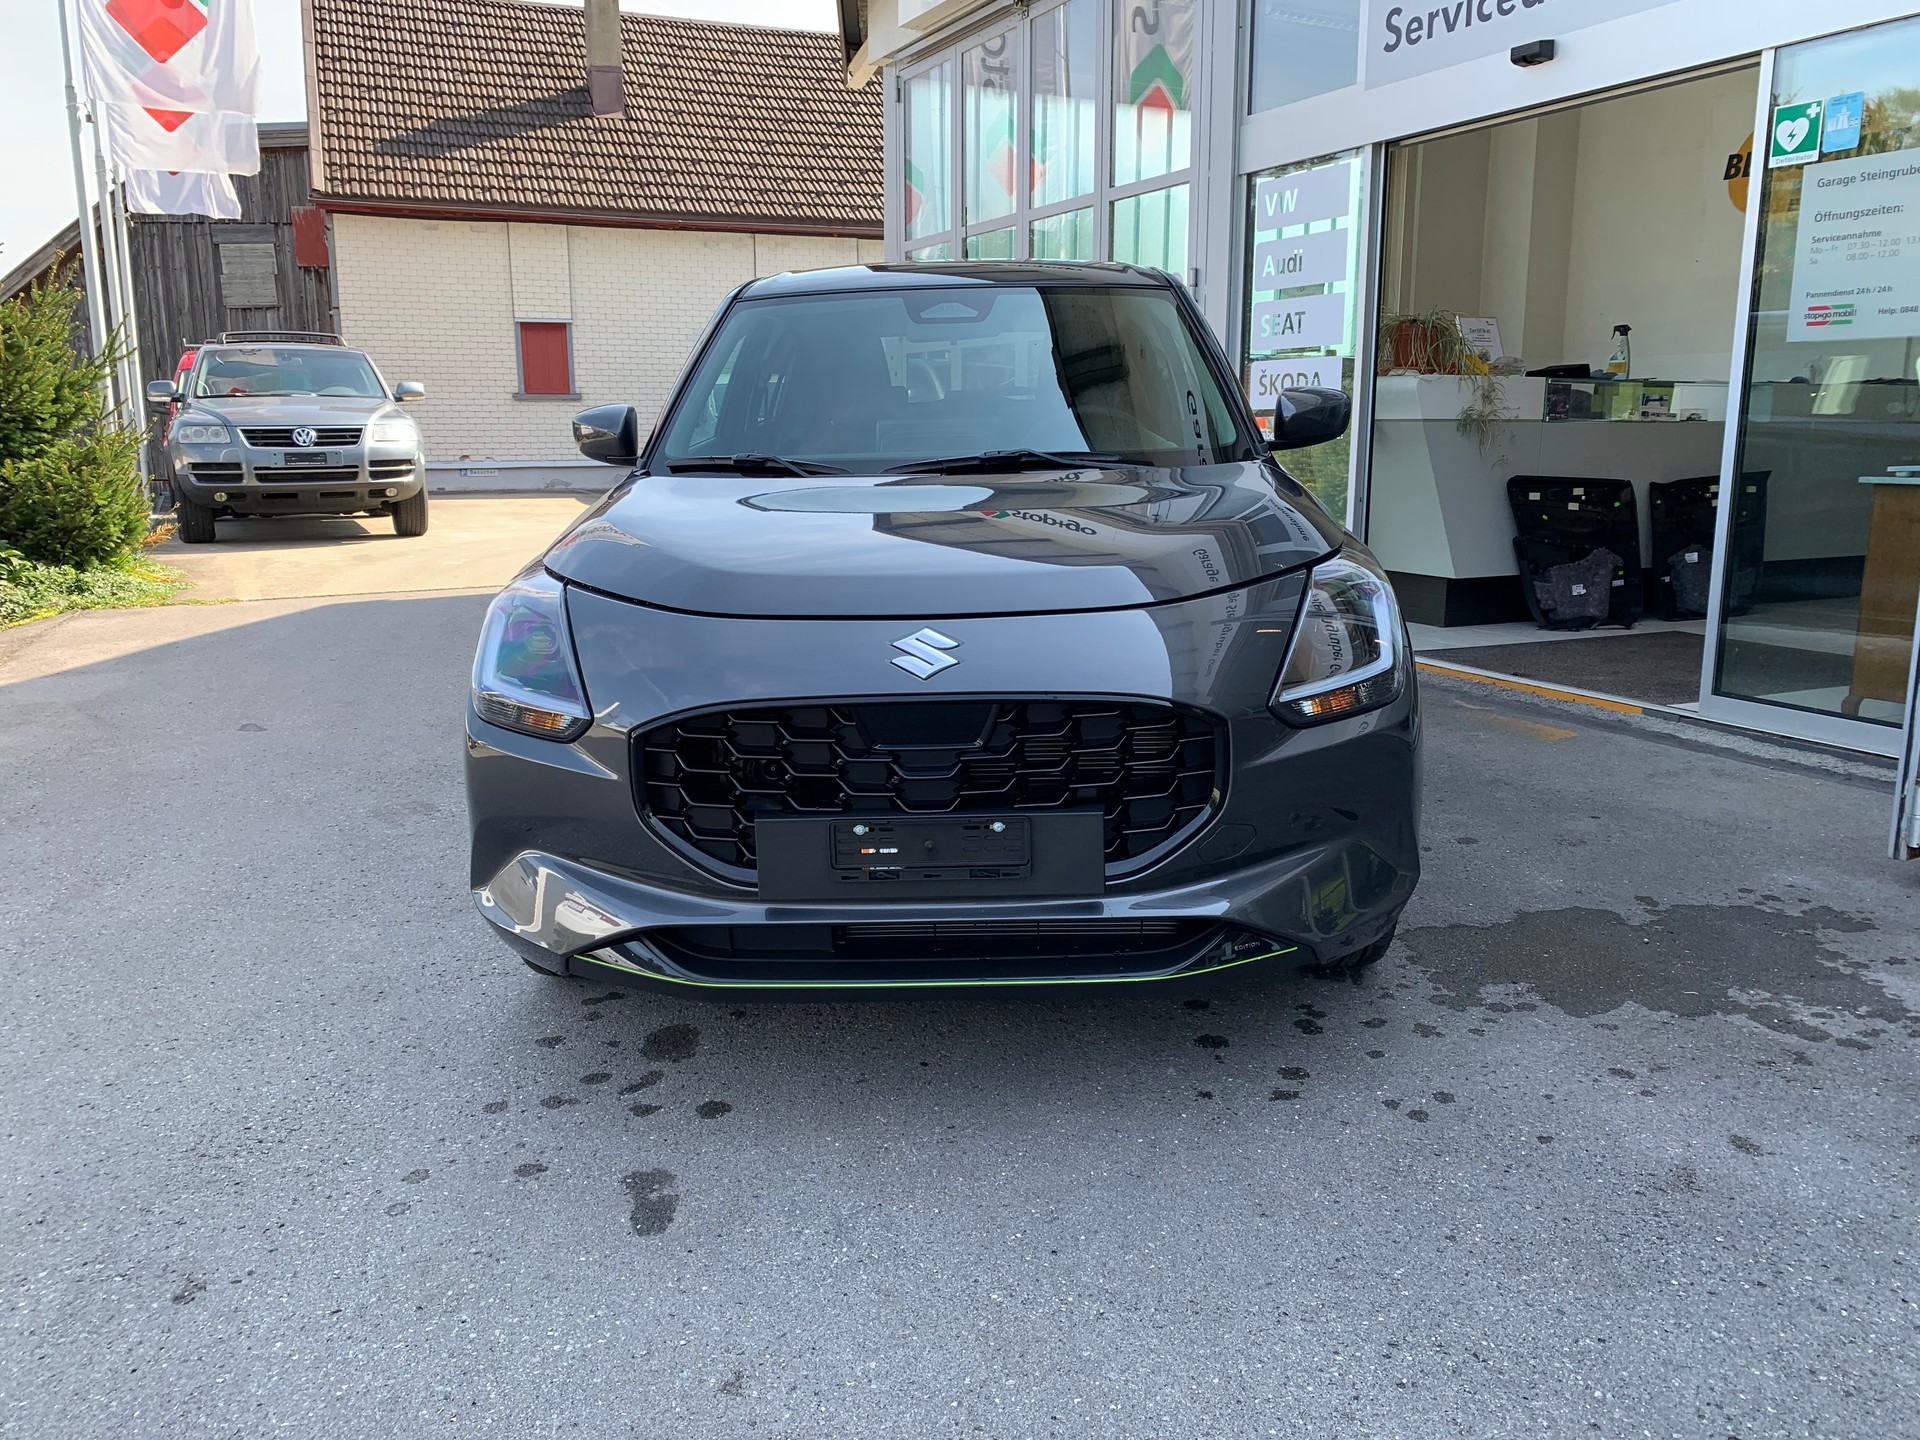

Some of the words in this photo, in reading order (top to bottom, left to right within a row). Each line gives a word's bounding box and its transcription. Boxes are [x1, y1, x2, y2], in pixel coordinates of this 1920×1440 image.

[1817, 174, 1857, 188] Garage
[1264, 187, 1299, 217] VW
[1814, 204, 1904, 223] Öffnungszeiten:
[1811, 230, 1882, 244] Serviceannahme
[1262, 249, 1303, 277] Audi
[1809, 257, 1818, 265] Sa
[1806, 289, 1854, 298] Pannendienst
[1878, 307, 1897, 316] Help:
[1900, 305, 1919, 314] 0848
[1260, 311, 1306, 338] SEAT
